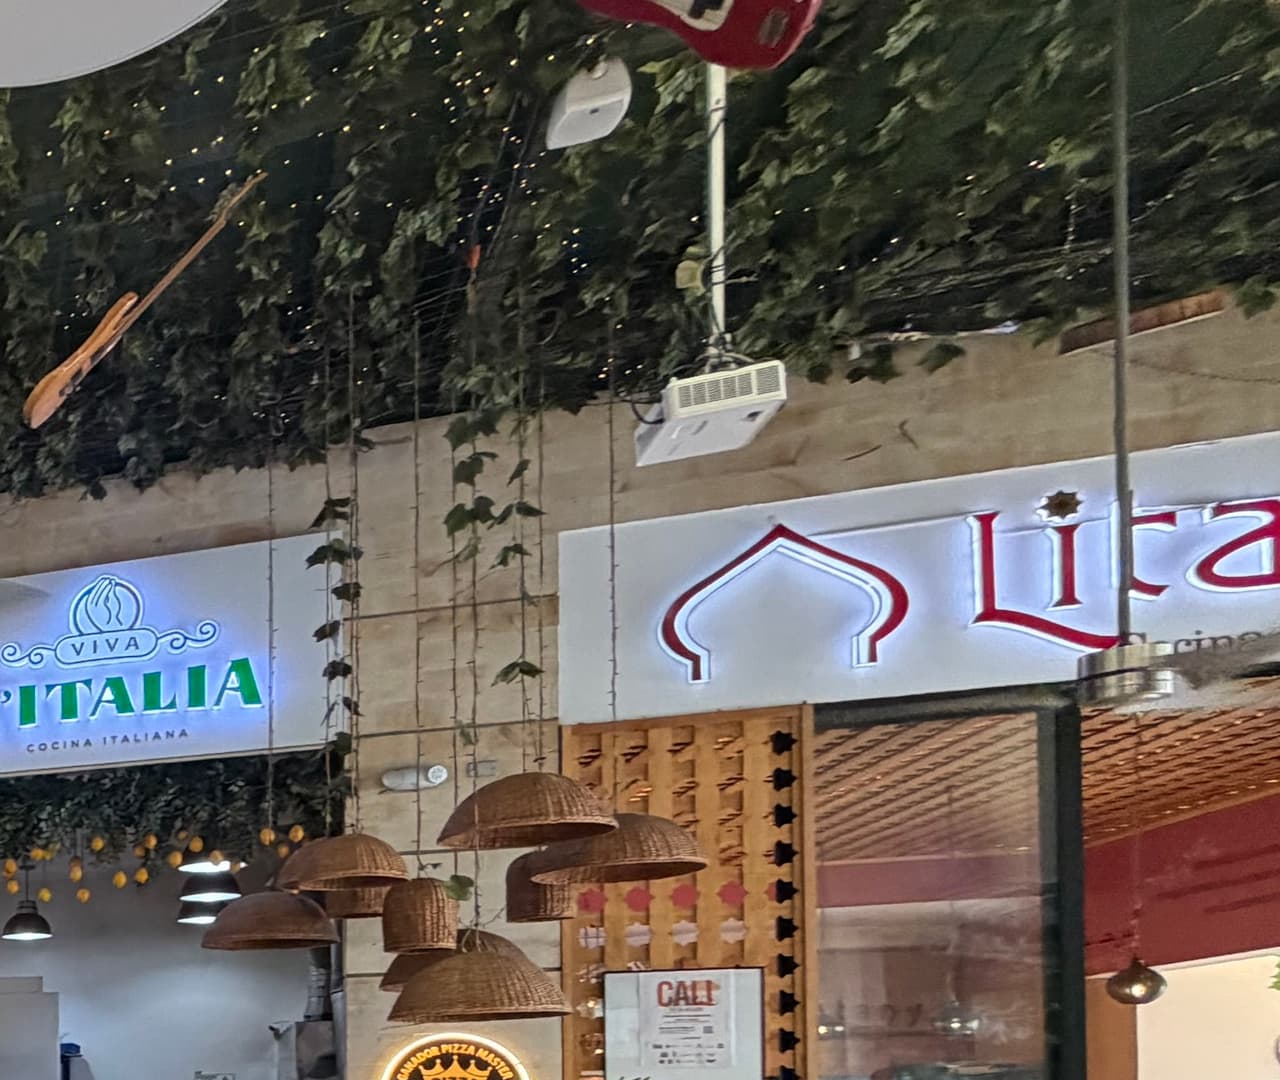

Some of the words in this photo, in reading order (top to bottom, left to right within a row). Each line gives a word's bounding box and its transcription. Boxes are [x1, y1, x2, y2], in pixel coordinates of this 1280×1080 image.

[72, 637, 140, 656] VIVA
[27, 737, 92, 753] COCINA
[103, 728, 189, 745] ITALIANA
[441, 1043, 474, 1054] PIZZA
[476, 1047, 514, 1080] MASTER
